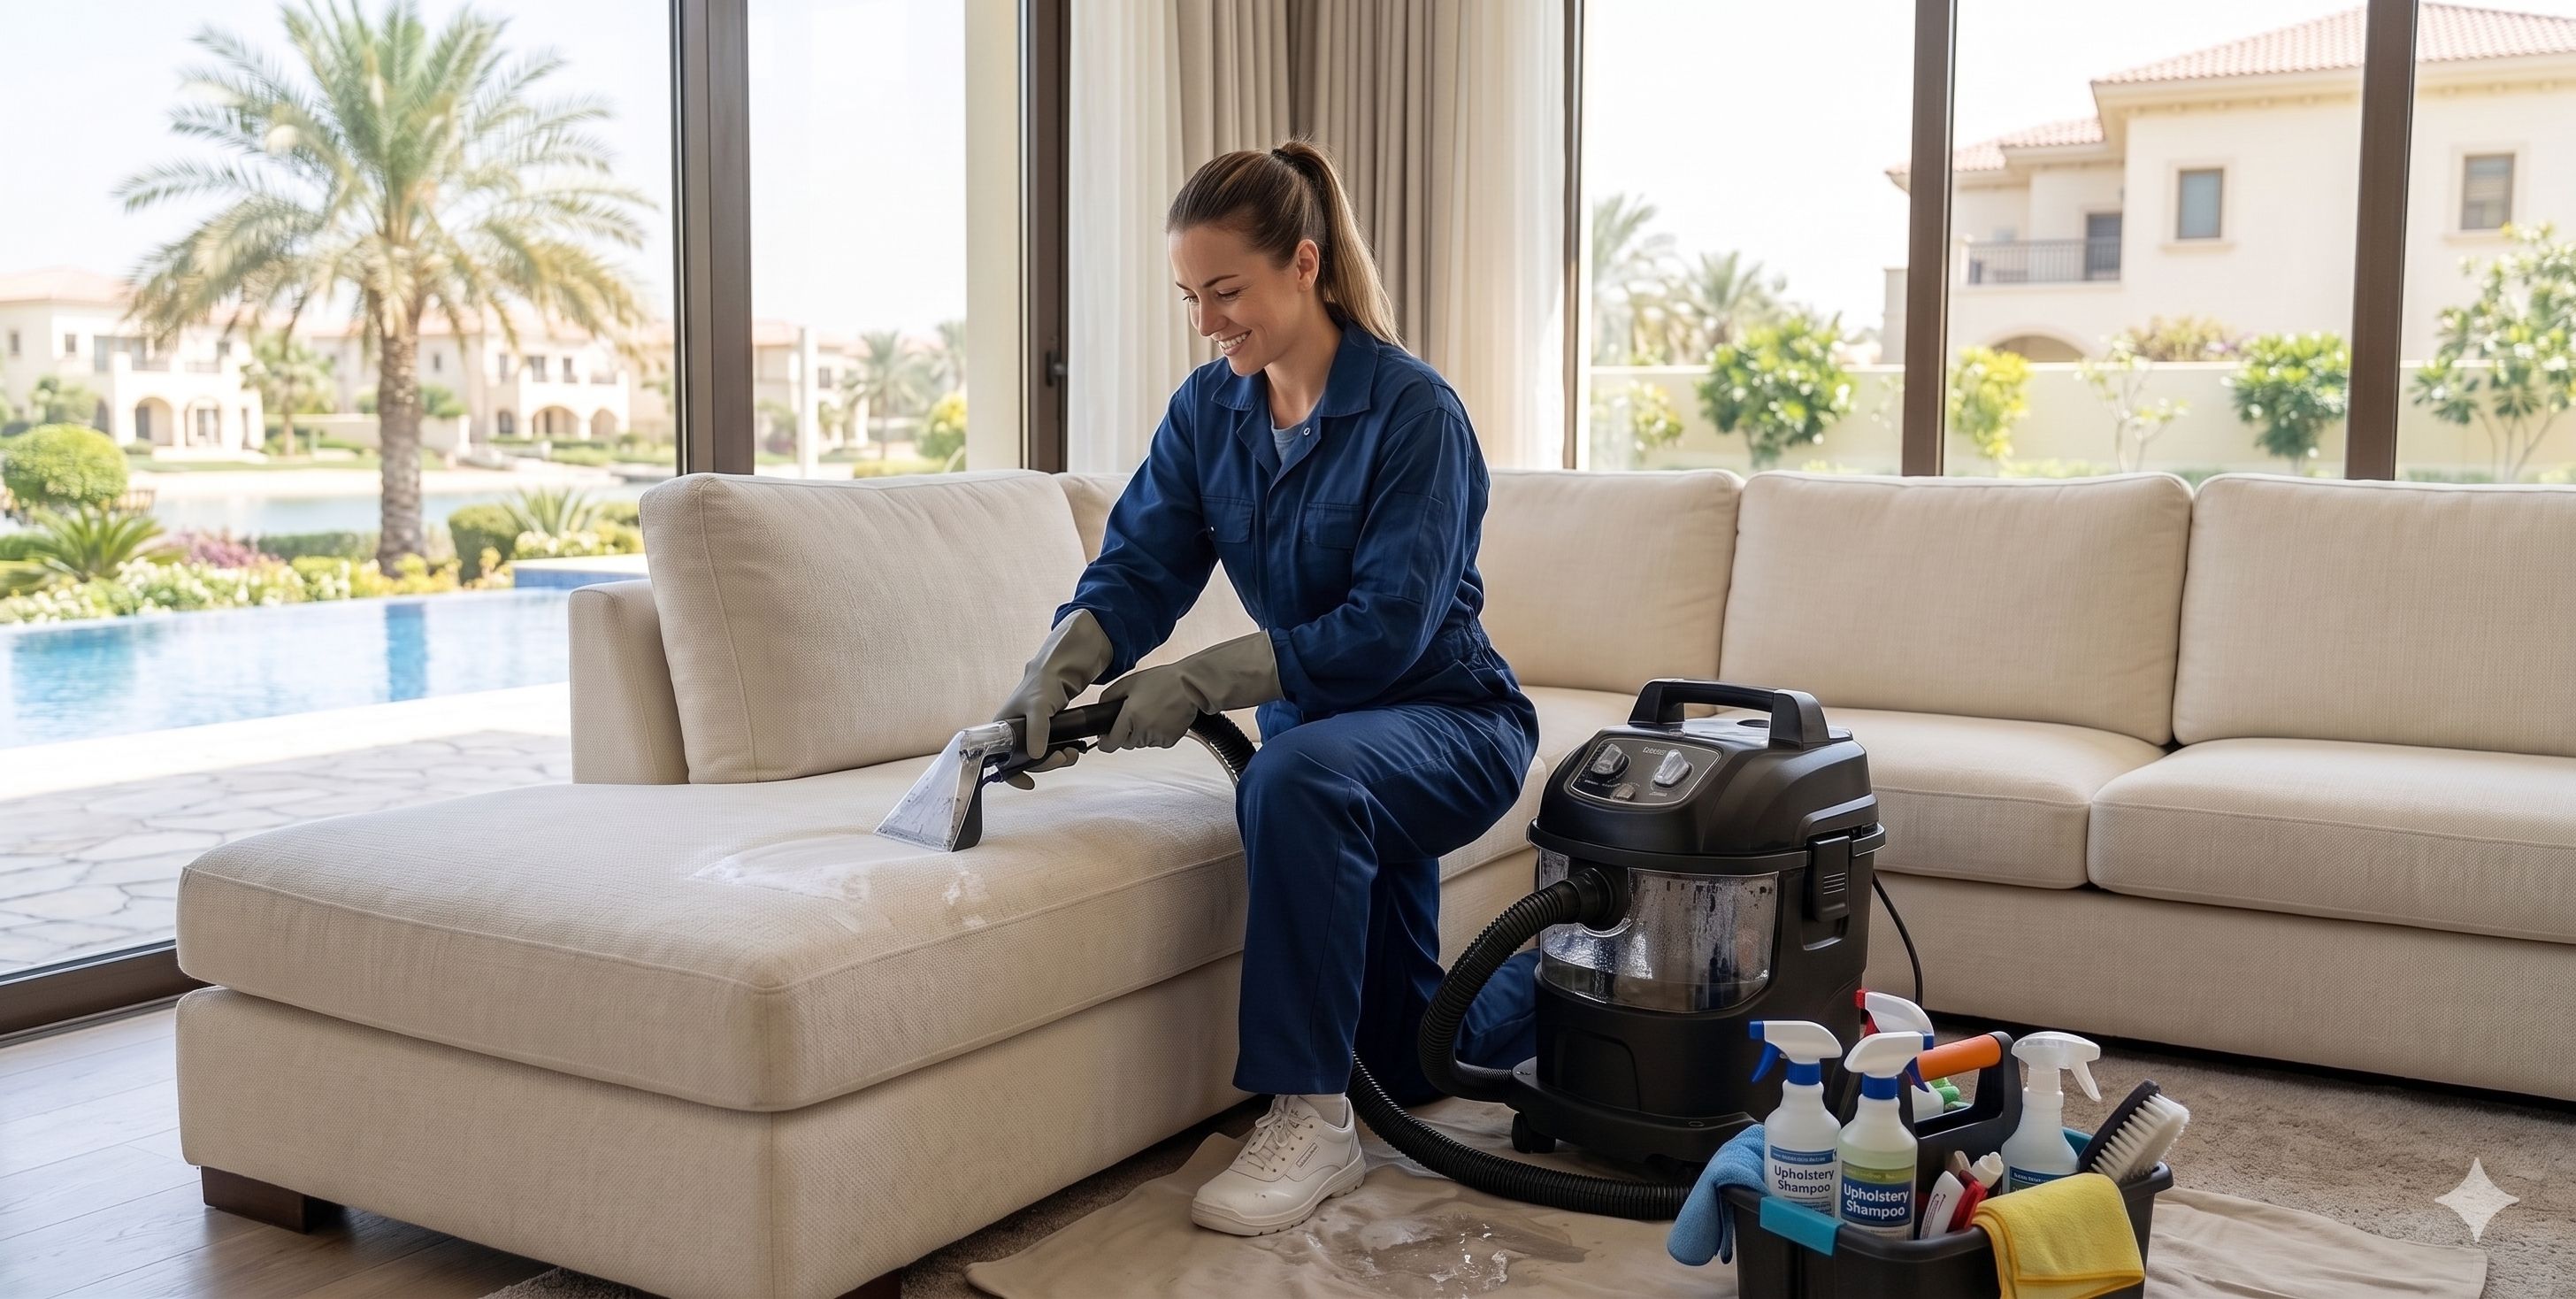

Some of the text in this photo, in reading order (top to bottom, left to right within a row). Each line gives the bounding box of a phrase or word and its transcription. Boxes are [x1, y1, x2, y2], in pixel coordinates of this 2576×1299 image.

[1774, 1164, 1835, 1180] Upholstery
[1777, 1180, 1831, 1195] Shampoo
[1844, 1183, 1909, 1203] Upholstery
[1845, 1200, 1905, 1219] Shampoo
